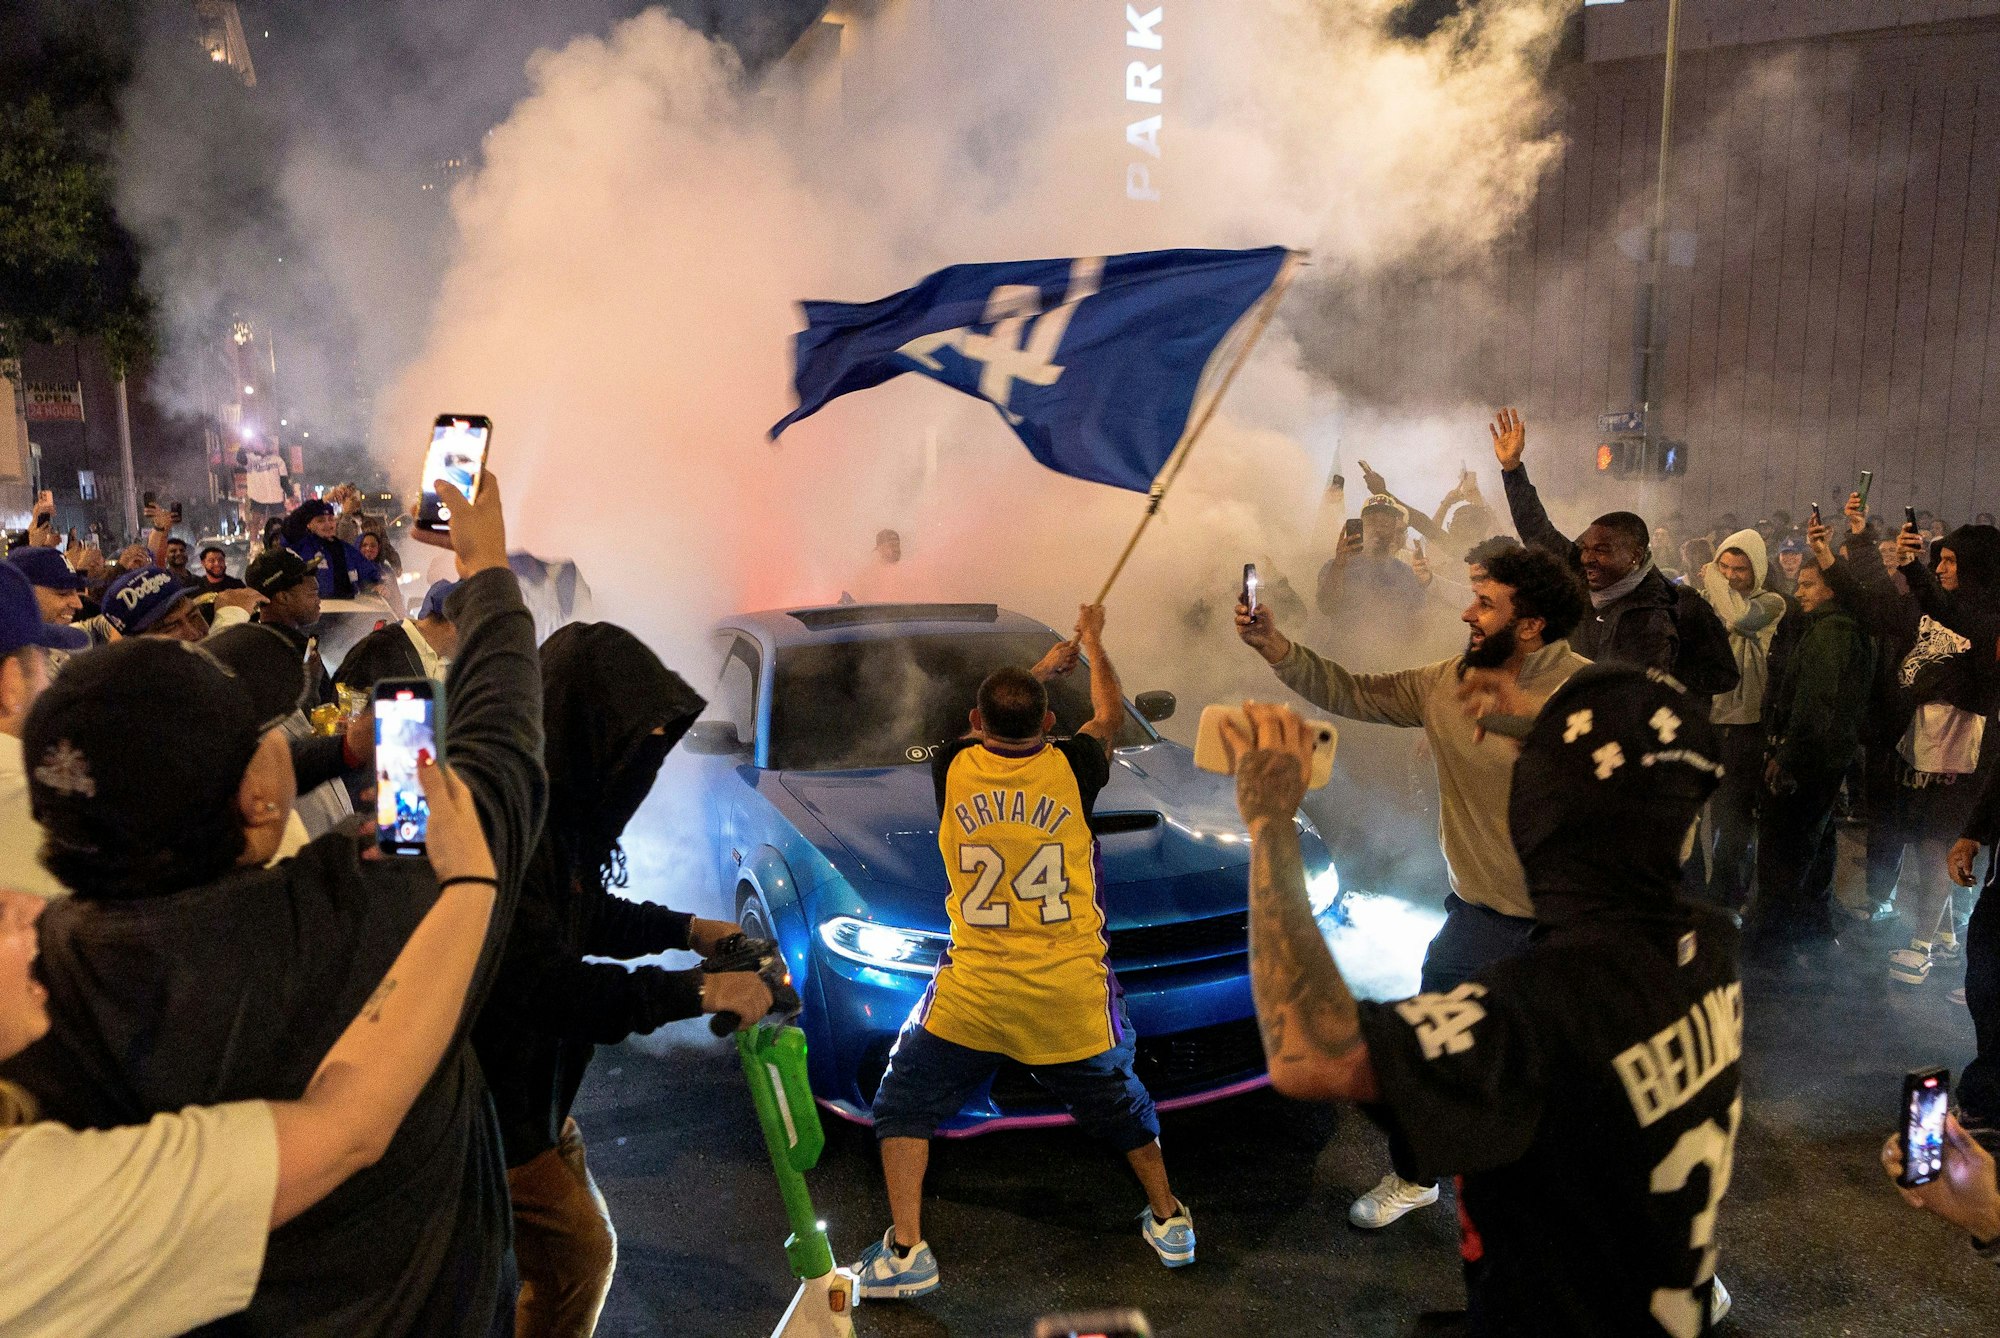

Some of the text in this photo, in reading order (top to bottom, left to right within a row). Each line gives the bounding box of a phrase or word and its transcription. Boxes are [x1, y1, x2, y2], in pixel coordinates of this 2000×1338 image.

[1126, 3, 1163, 202] PARK
[26, 382, 78, 392] PARKING
[34, 393, 72, 402] OPEN
[116, 573, 171, 610] Dodgers
[954, 789, 1072, 836] BRYANT
[959, 842, 1071, 928] 24
[1650, 1096, 1743, 1338] 3
